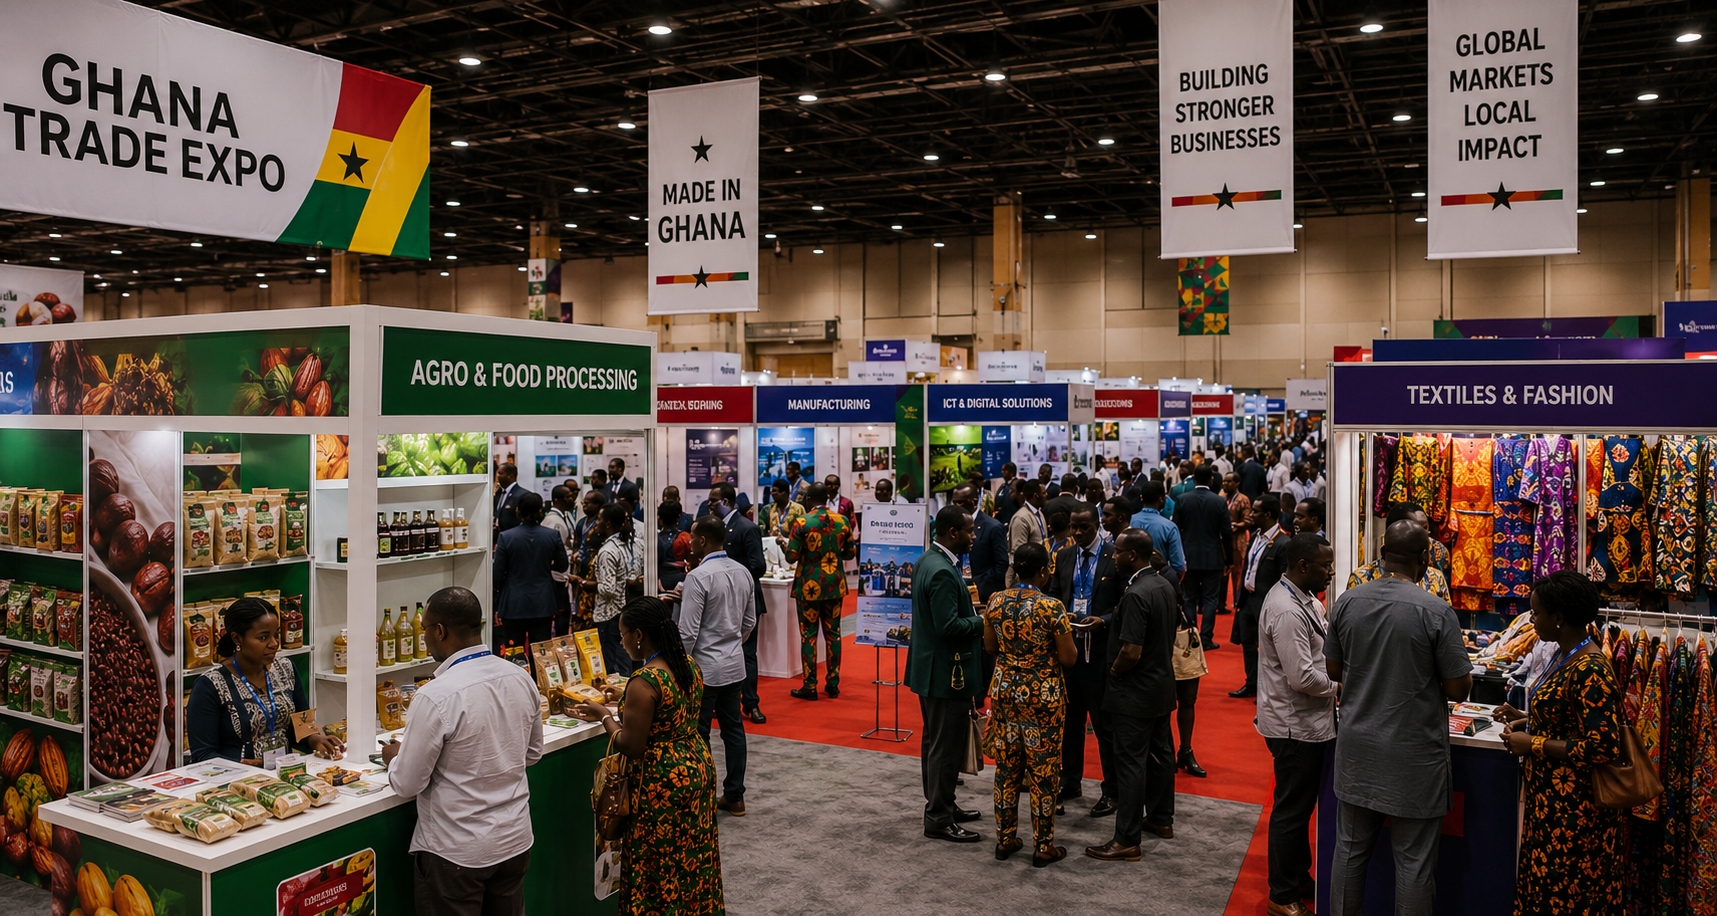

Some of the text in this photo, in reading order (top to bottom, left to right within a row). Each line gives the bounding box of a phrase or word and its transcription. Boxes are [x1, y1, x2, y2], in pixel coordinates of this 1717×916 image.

[1455, 27, 1546, 58] GLOBAL
[1179, 63, 1269, 93] BUILDING
[1449, 61, 1554, 93] MARKETS
[41, 52, 240, 140] GHANA
[1175, 94, 1275, 124] STRONGER
[1464, 99, 1537, 127] LOCAL
[3, 102, 286, 193] TRADE EXPO
[1170, 125, 1281, 155] BUSINESSES
[1458, 134, 1543, 162] IMPACT
[662, 178, 741, 206] MADE IN
[657, 210, 746, 244] GHANA
[410, 359, 638, 391] AGRO & FOOD PROCESSING
[787, 398, 871, 410] MANUFACTURING
[943, 397, 1053, 409] ICT & DIGITAL SOLUTIONS
[1406, 384, 1614, 405] TEXTILES & FASHION
